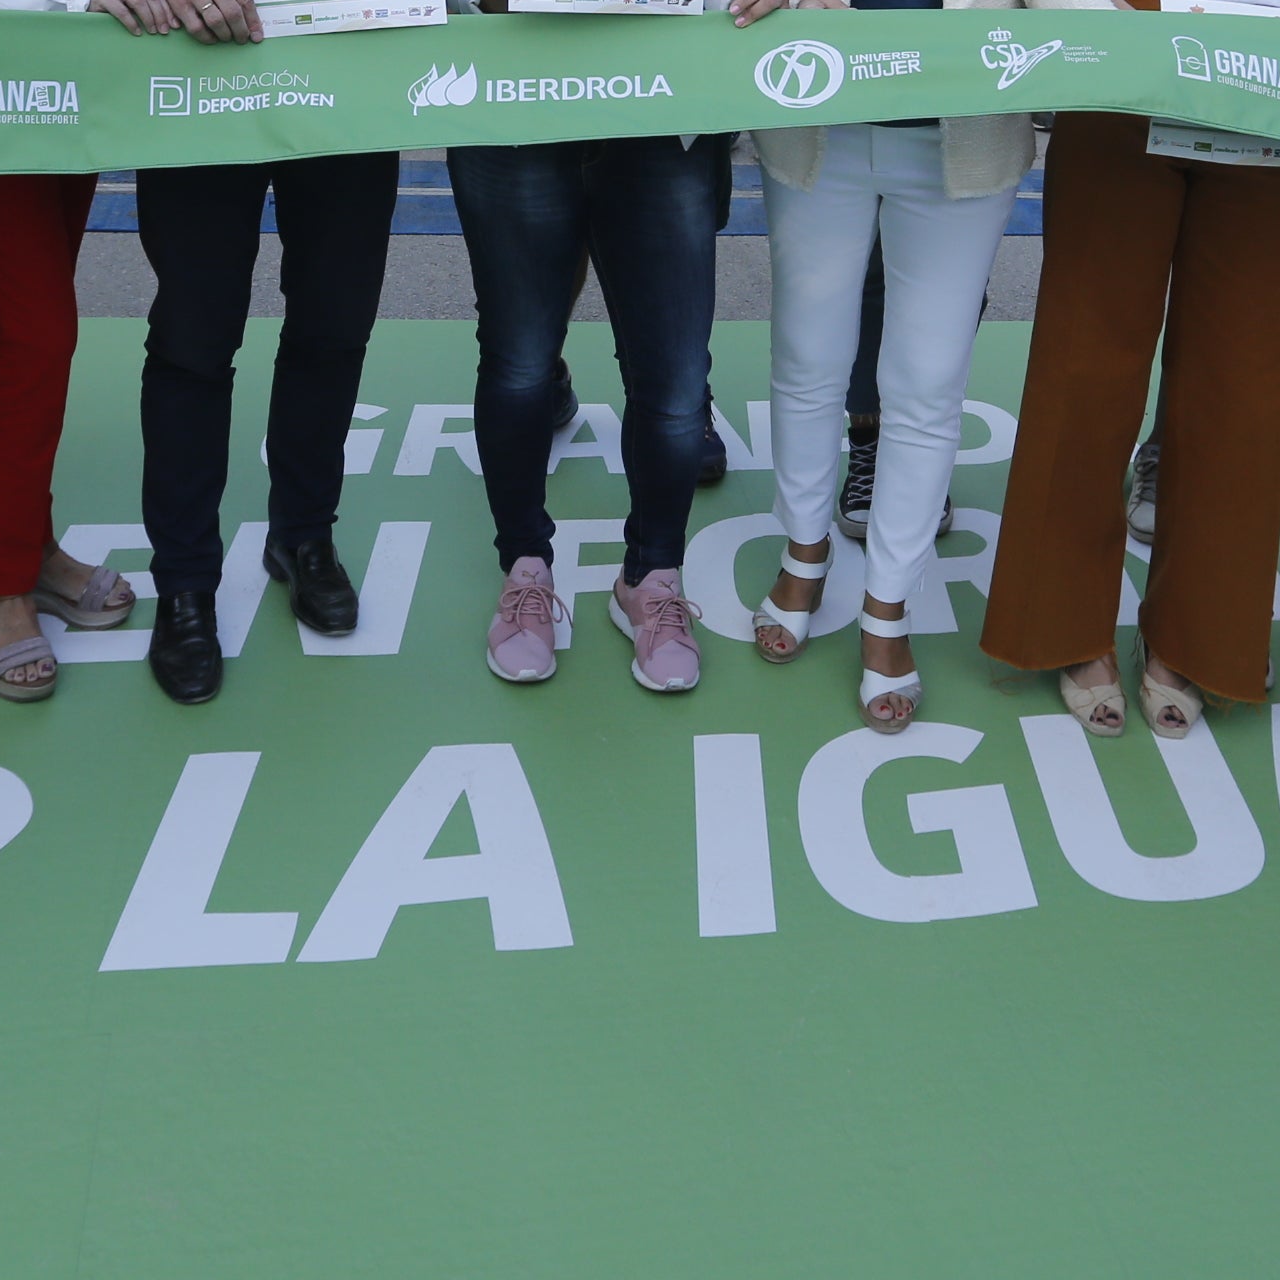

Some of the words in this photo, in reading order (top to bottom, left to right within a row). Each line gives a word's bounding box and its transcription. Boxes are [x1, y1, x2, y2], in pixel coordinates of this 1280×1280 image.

[849, 51, 920, 64] UNIVERSO
[199, 69, 310, 92] FUNDACIÓN
[851, 60, 922, 80] MUJER
[36, 85, 49, 108] 2019
[485, 73, 674, 104] IBERDROLA
[1217, 75, 1244, 89] CIUDAD
[1245, 81, 1276, 99] EUROPEA
[198, 93, 270, 114] DEPORTE
[274, 91, 335, 107] JOVEN
[25, 114, 40, 124] DEL
[41, 115, 80, 125] DEPORTE
[98, 744, 574, 973] LA
